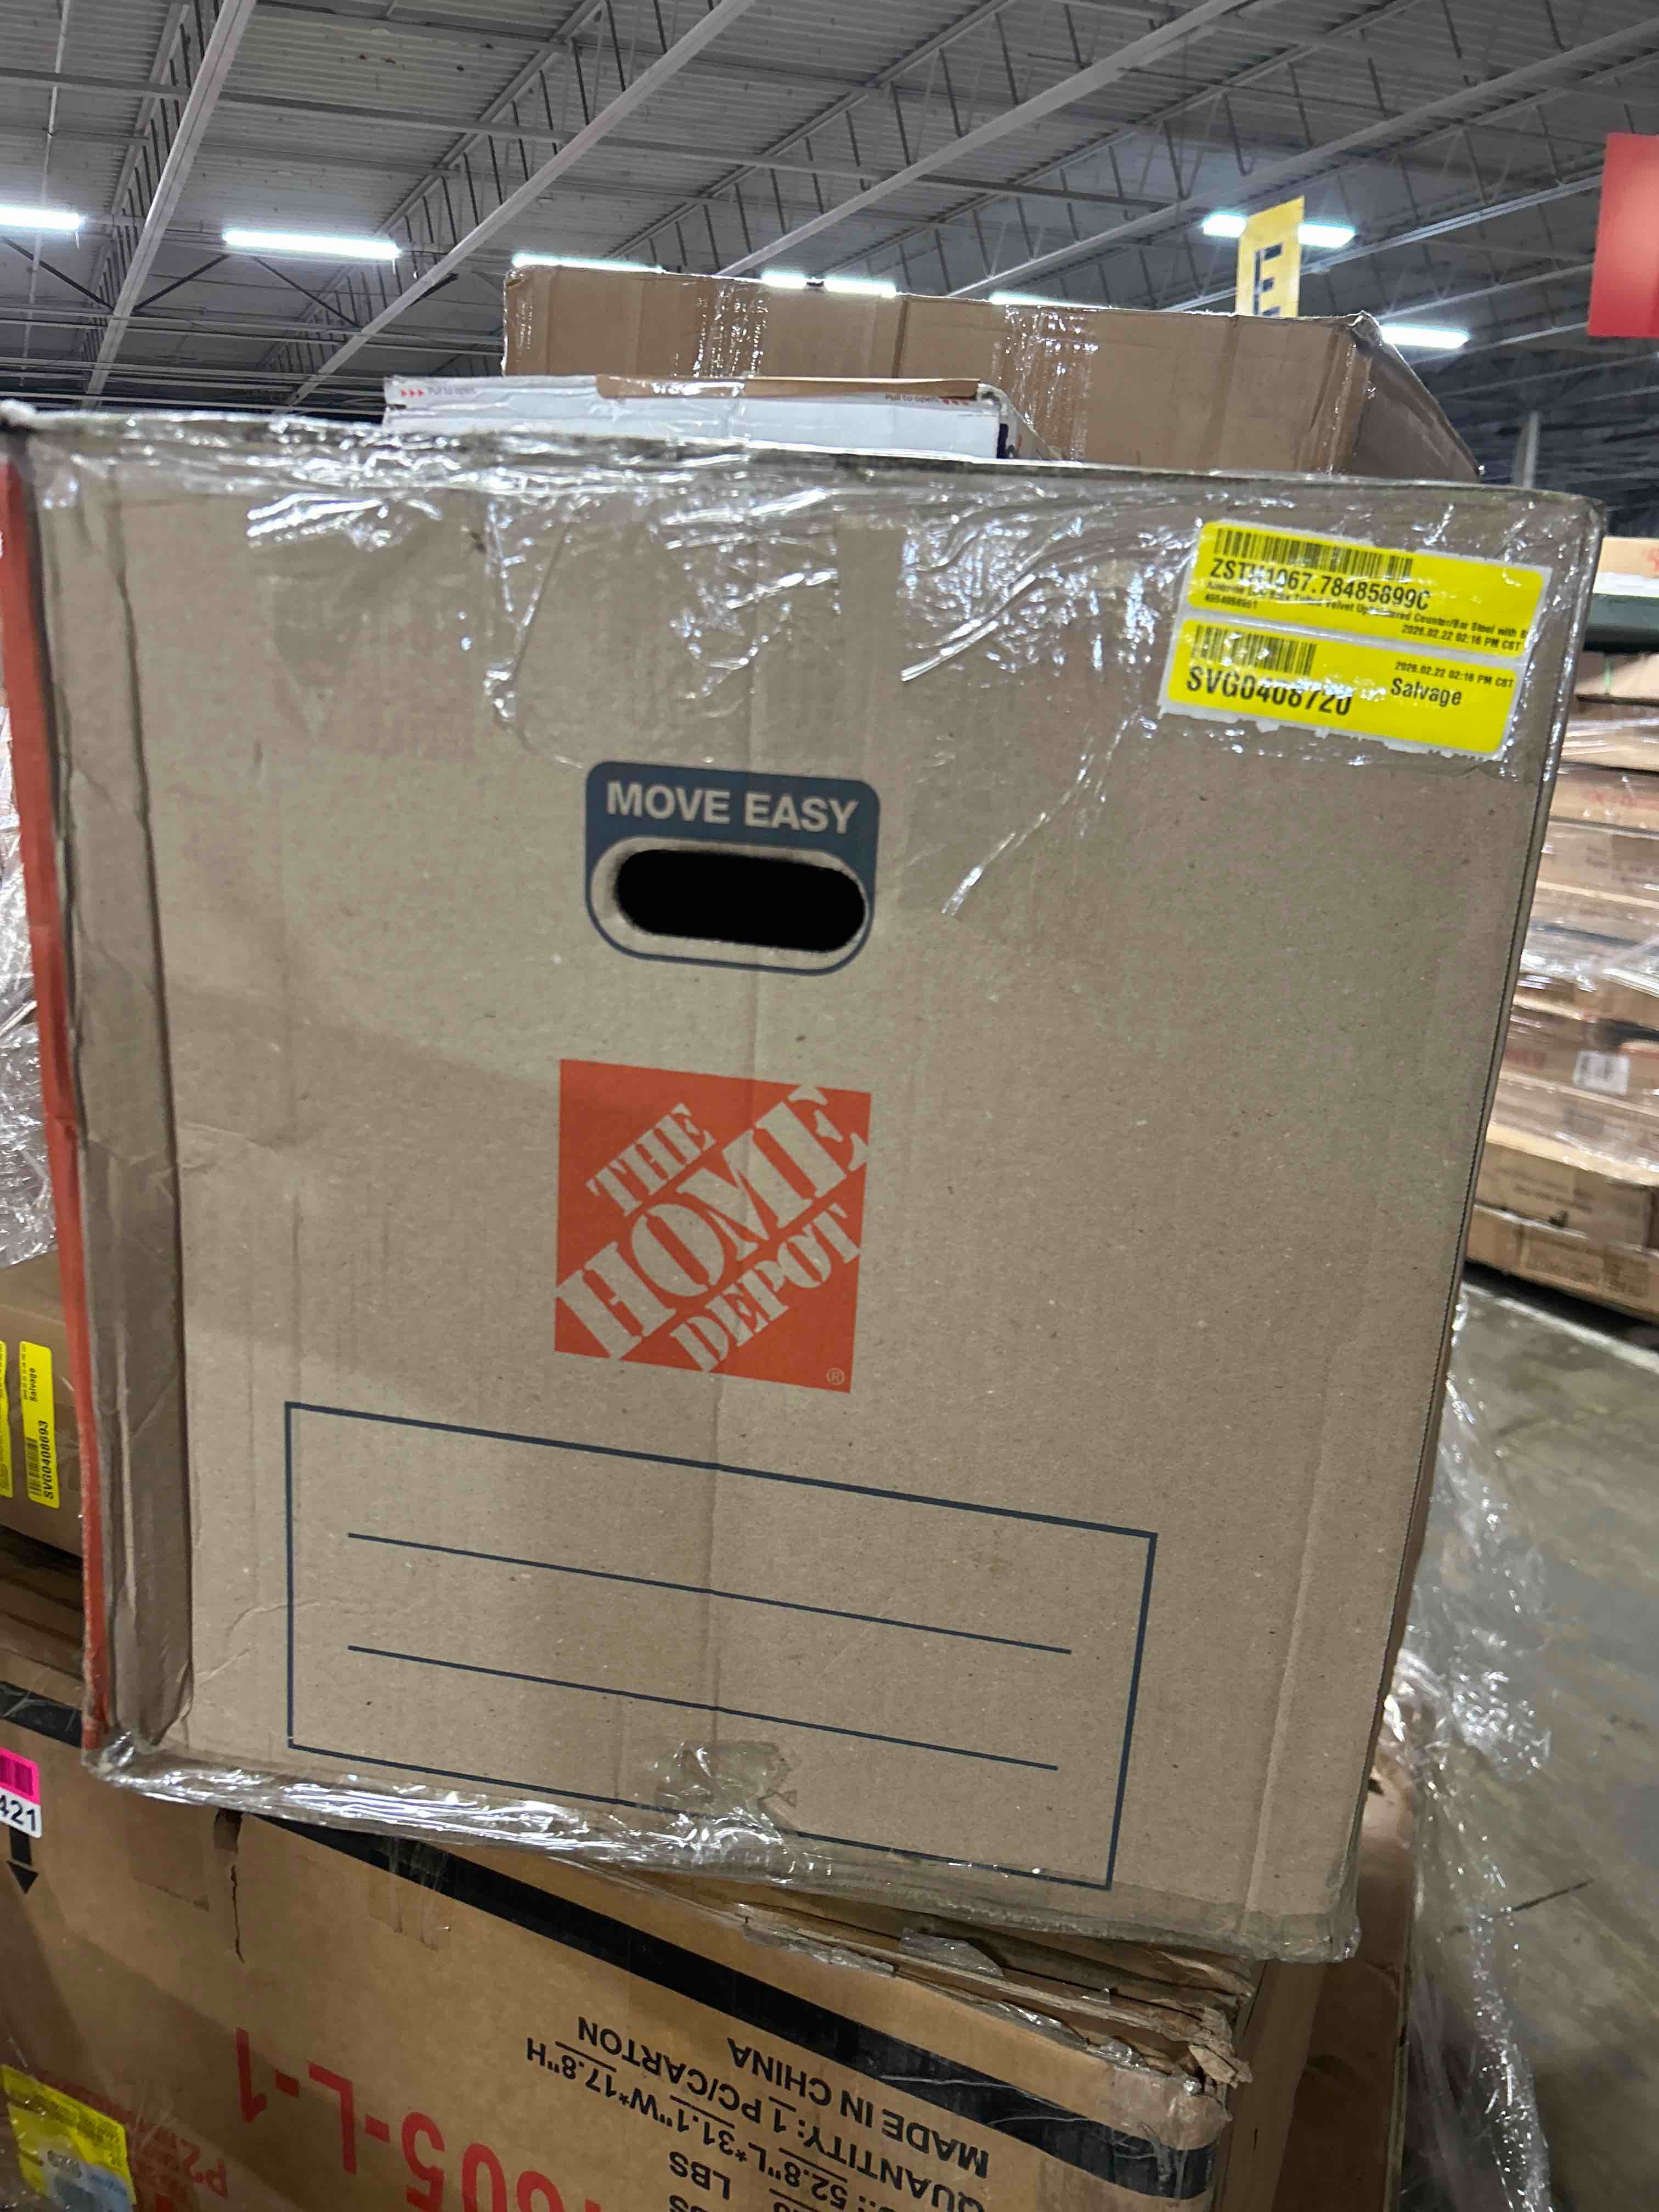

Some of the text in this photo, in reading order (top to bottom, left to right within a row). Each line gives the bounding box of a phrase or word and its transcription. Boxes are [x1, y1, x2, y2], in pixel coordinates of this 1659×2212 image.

[1477, 674, 1493, 686] PM
[1483, 634, 1500, 648] PM
[1391, 676, 1463, 708] Salvage
[606, 781, 859, 835] MOVE EASY
[585, 1103, 716, 1217] THE
[554, 1084, 870, 1359] HOME
[669, 1203, 861, 1373] DEPOT
[29, 1367, 38, 1403] Salvage
[578, 2016, 763, 2124] PC/CARTON
[726, 2036, 990, 2179] MADE IN CHINA
[236, 2027, 602, 2212] 05-L-1
[798, 2119, 984, 2212] QUANTITY:
[669, 2150, 731, 2200] LBS
